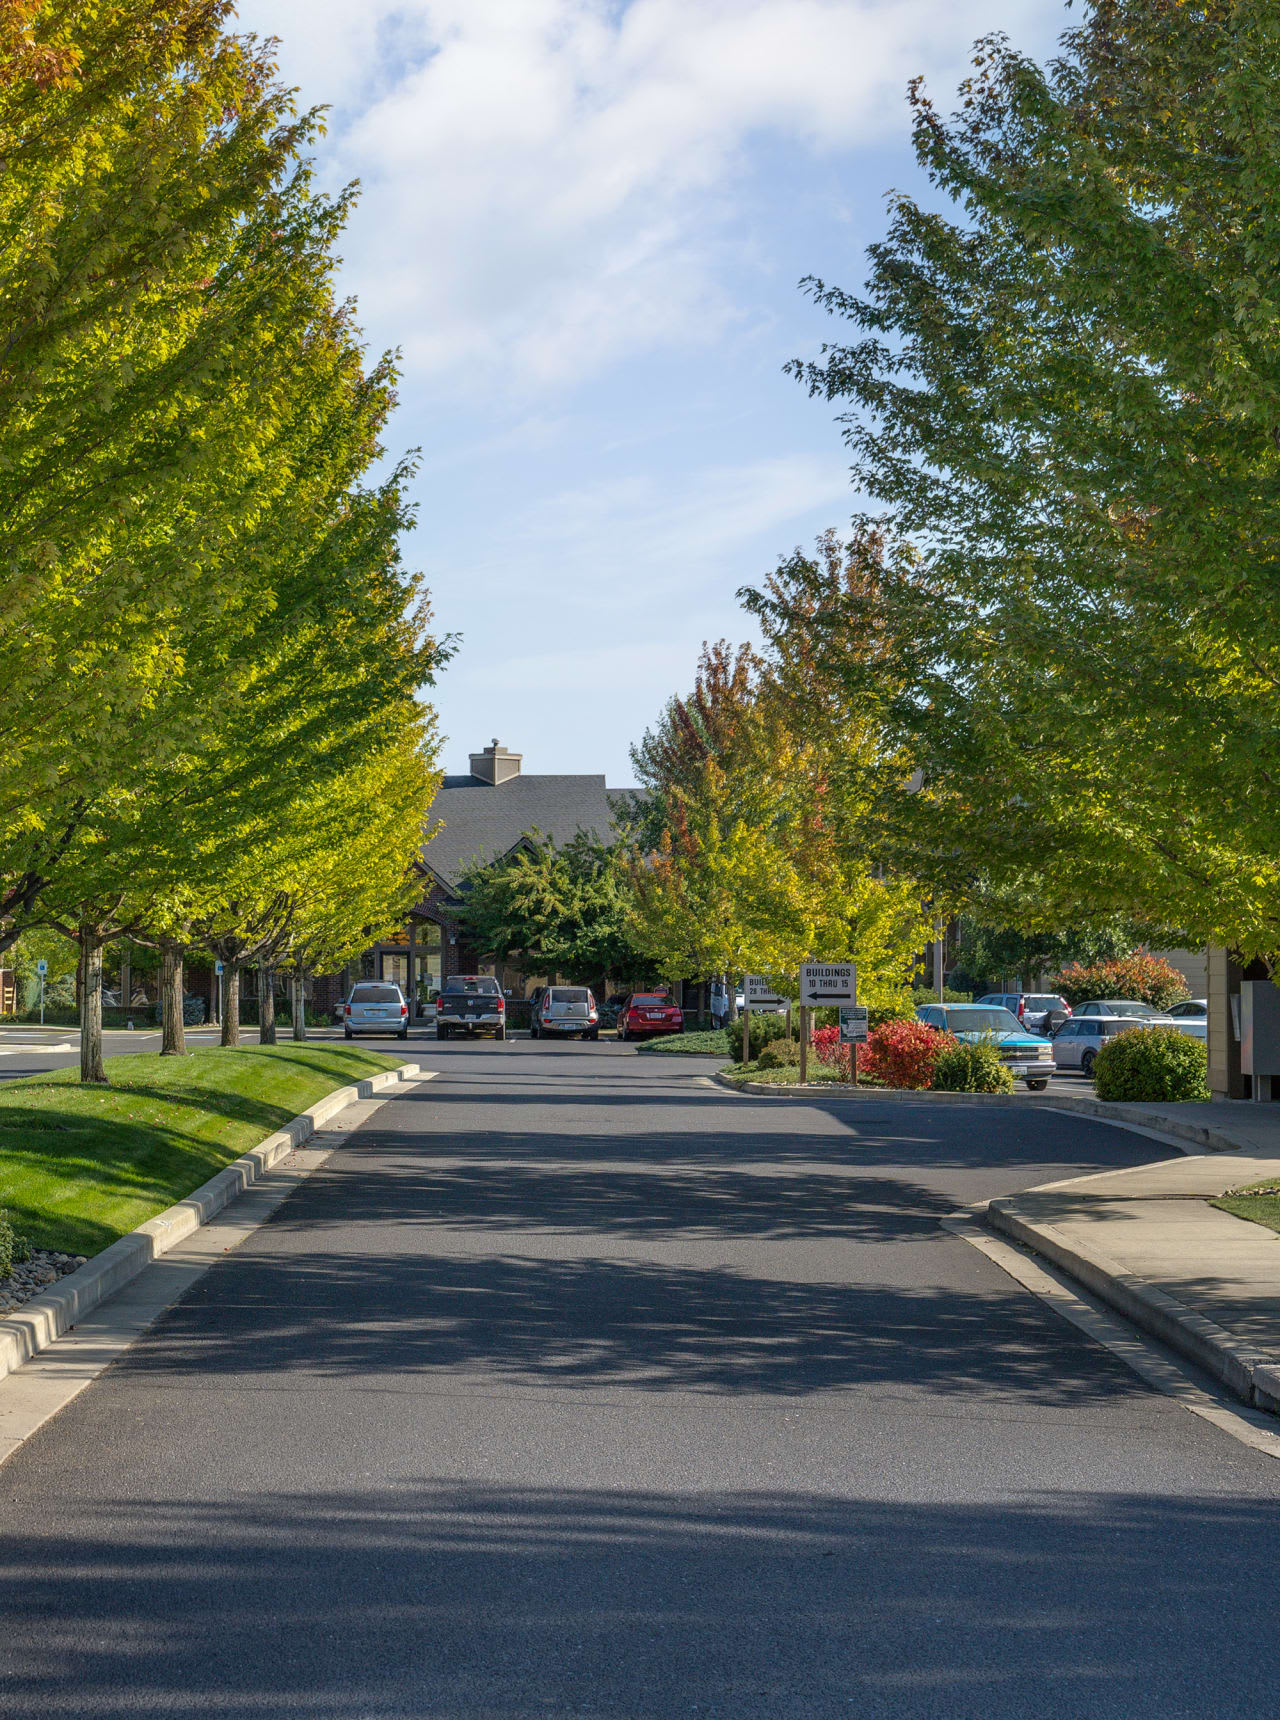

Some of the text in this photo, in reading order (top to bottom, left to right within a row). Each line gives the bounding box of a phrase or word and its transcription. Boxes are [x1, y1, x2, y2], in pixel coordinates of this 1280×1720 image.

[806, 968, 851, 977] BUILDINGS
[808, 979, 849, 988] 10 THRU 15
